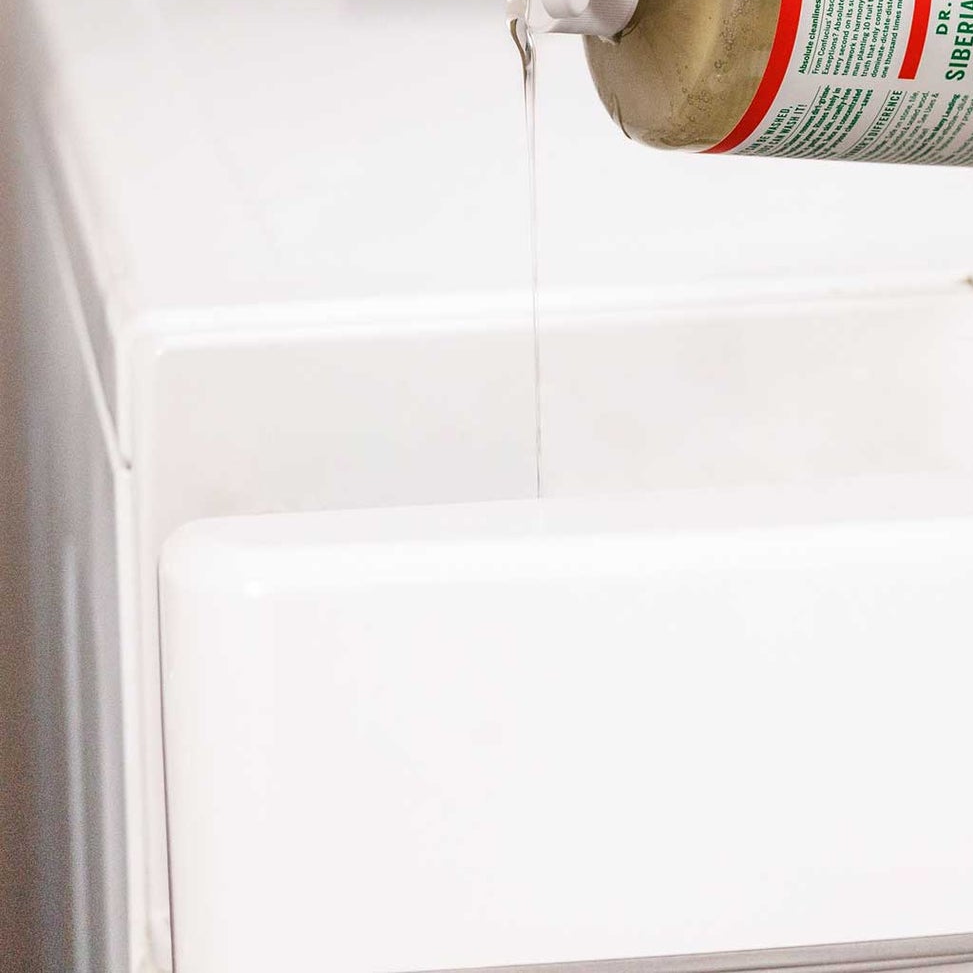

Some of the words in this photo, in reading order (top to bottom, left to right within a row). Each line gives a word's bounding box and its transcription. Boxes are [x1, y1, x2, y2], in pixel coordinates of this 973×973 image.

[844, 7, 853, 18] its
[863, 2, 873, 21] fruit
[890, 9, 901, 31] times
[935, 2, 952, 36] DR.
[844, 18, 851, 30] on
[861, 21, 870, 31] 10
[816, 17, 832, 57] Confucius'
[836, 29, 849, 57] second
[868, 25, 881, 44] only
[821, 31, 840, 77] Exceptions?
[840, 40, 856, 77] teamwork
[850, 32, 858, 41] in
[855, 30, 870, 62] planting
[864, 42, 875, 60] that
[883, 30, 897, 66] thousand
[797, 39, 814, 75] Absolute
[811, 55, 823, 75] From
[831, 56, 844, 77] every
[851, 60, 861, 77] man
[859, 58, 871, 78] truth
[880, 64, 889, 79] one
